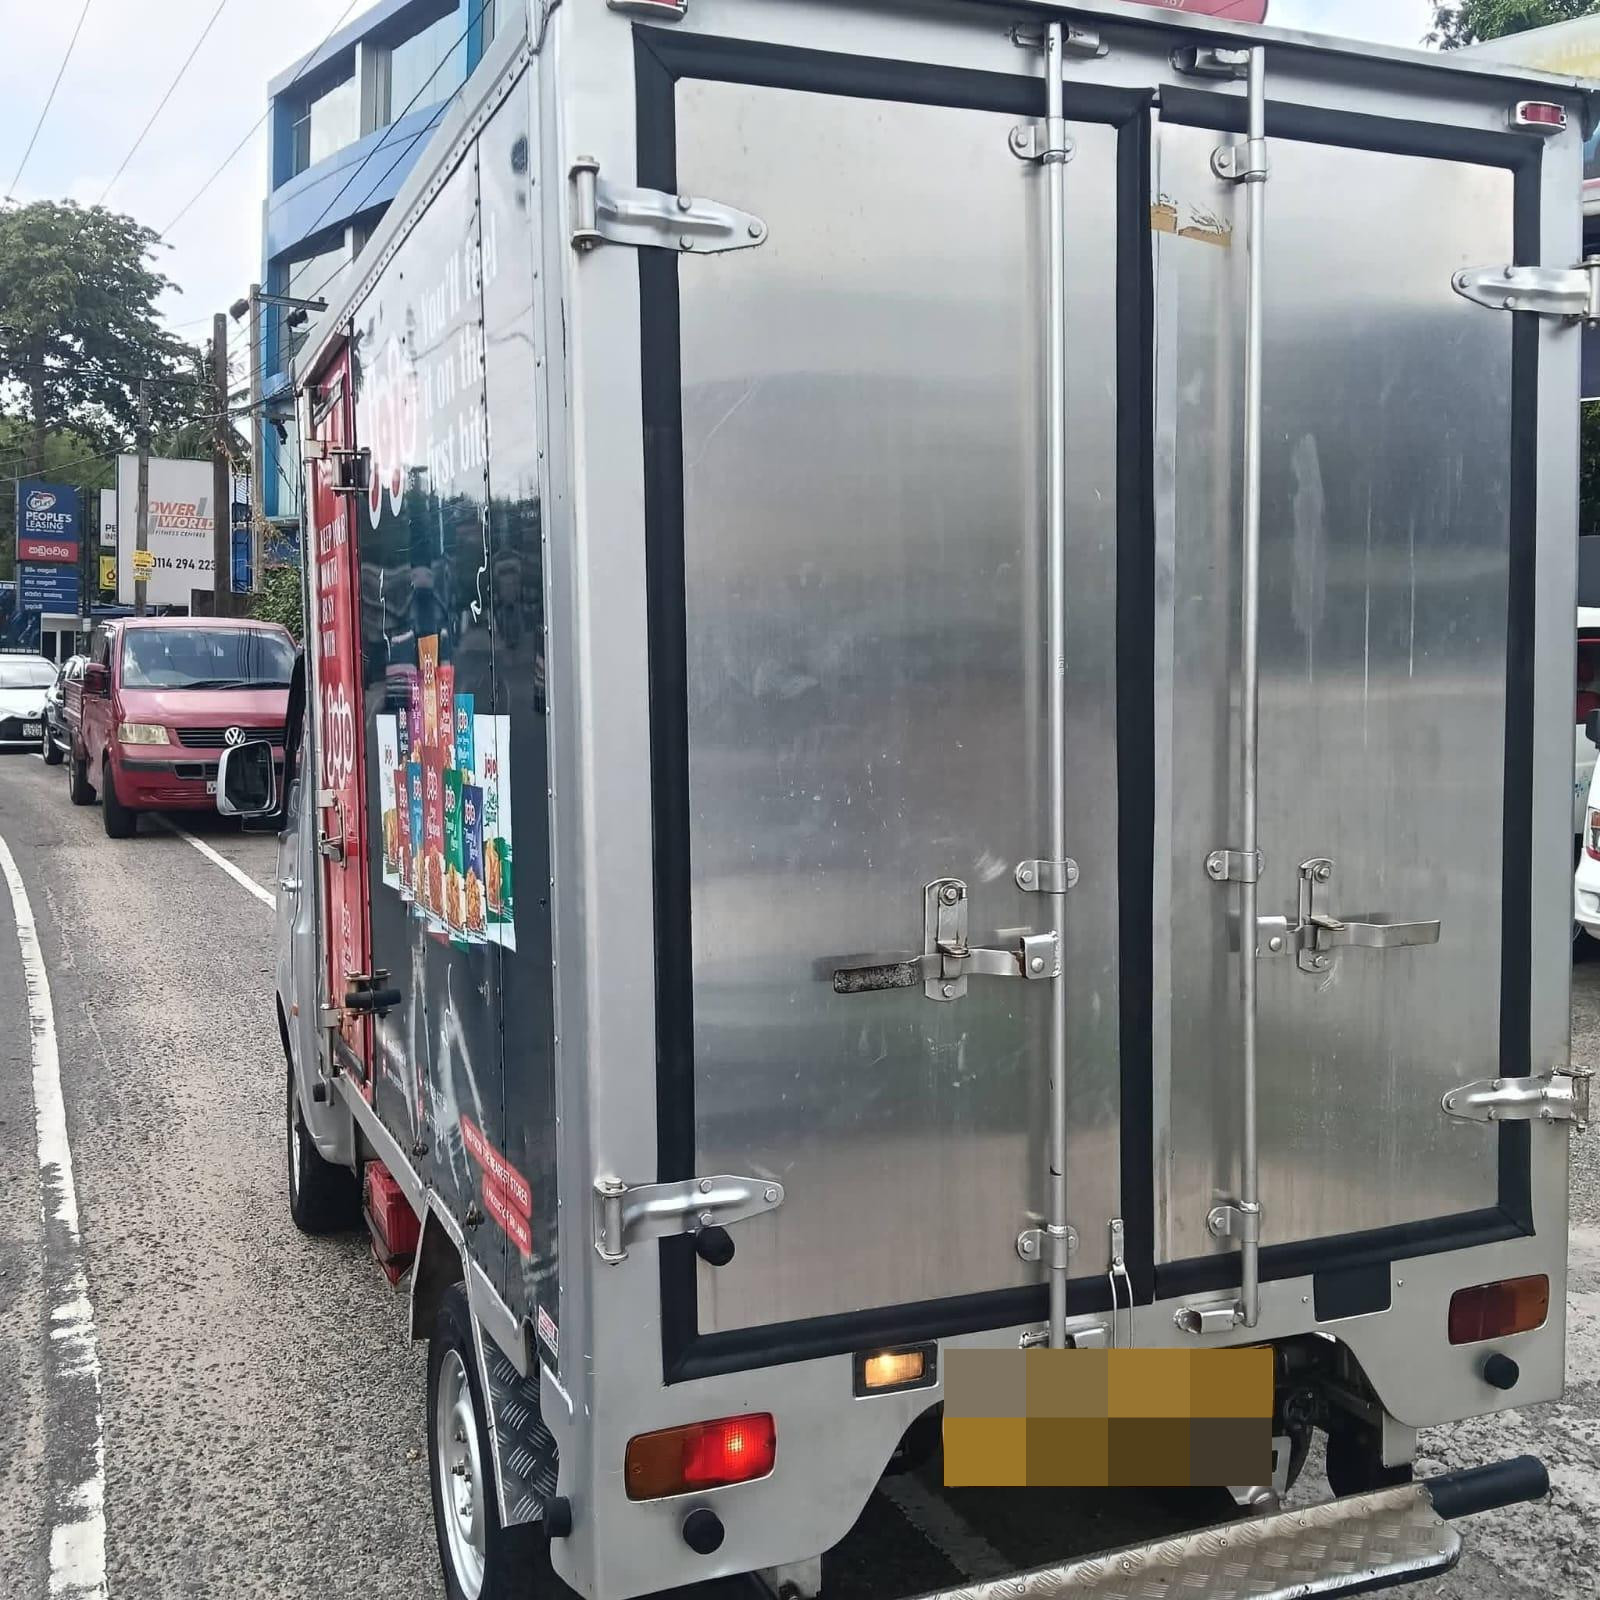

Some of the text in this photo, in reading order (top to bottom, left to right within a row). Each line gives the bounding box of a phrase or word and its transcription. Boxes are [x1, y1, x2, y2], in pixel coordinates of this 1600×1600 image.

[419, 209, 497, 346] You'll feel
[436, 353, 456, 410] on
[458, 322, 489, 390] the
[459, 403, 493, 475] bite
[26, 511, 72, 523] PEOPLE'S
[148, 501, 197, 516] OWER
[26, 520, 64, 530] LEASING
[176, 558, 195, 569] 294
[510, 1176, 528, 1207] STORES
